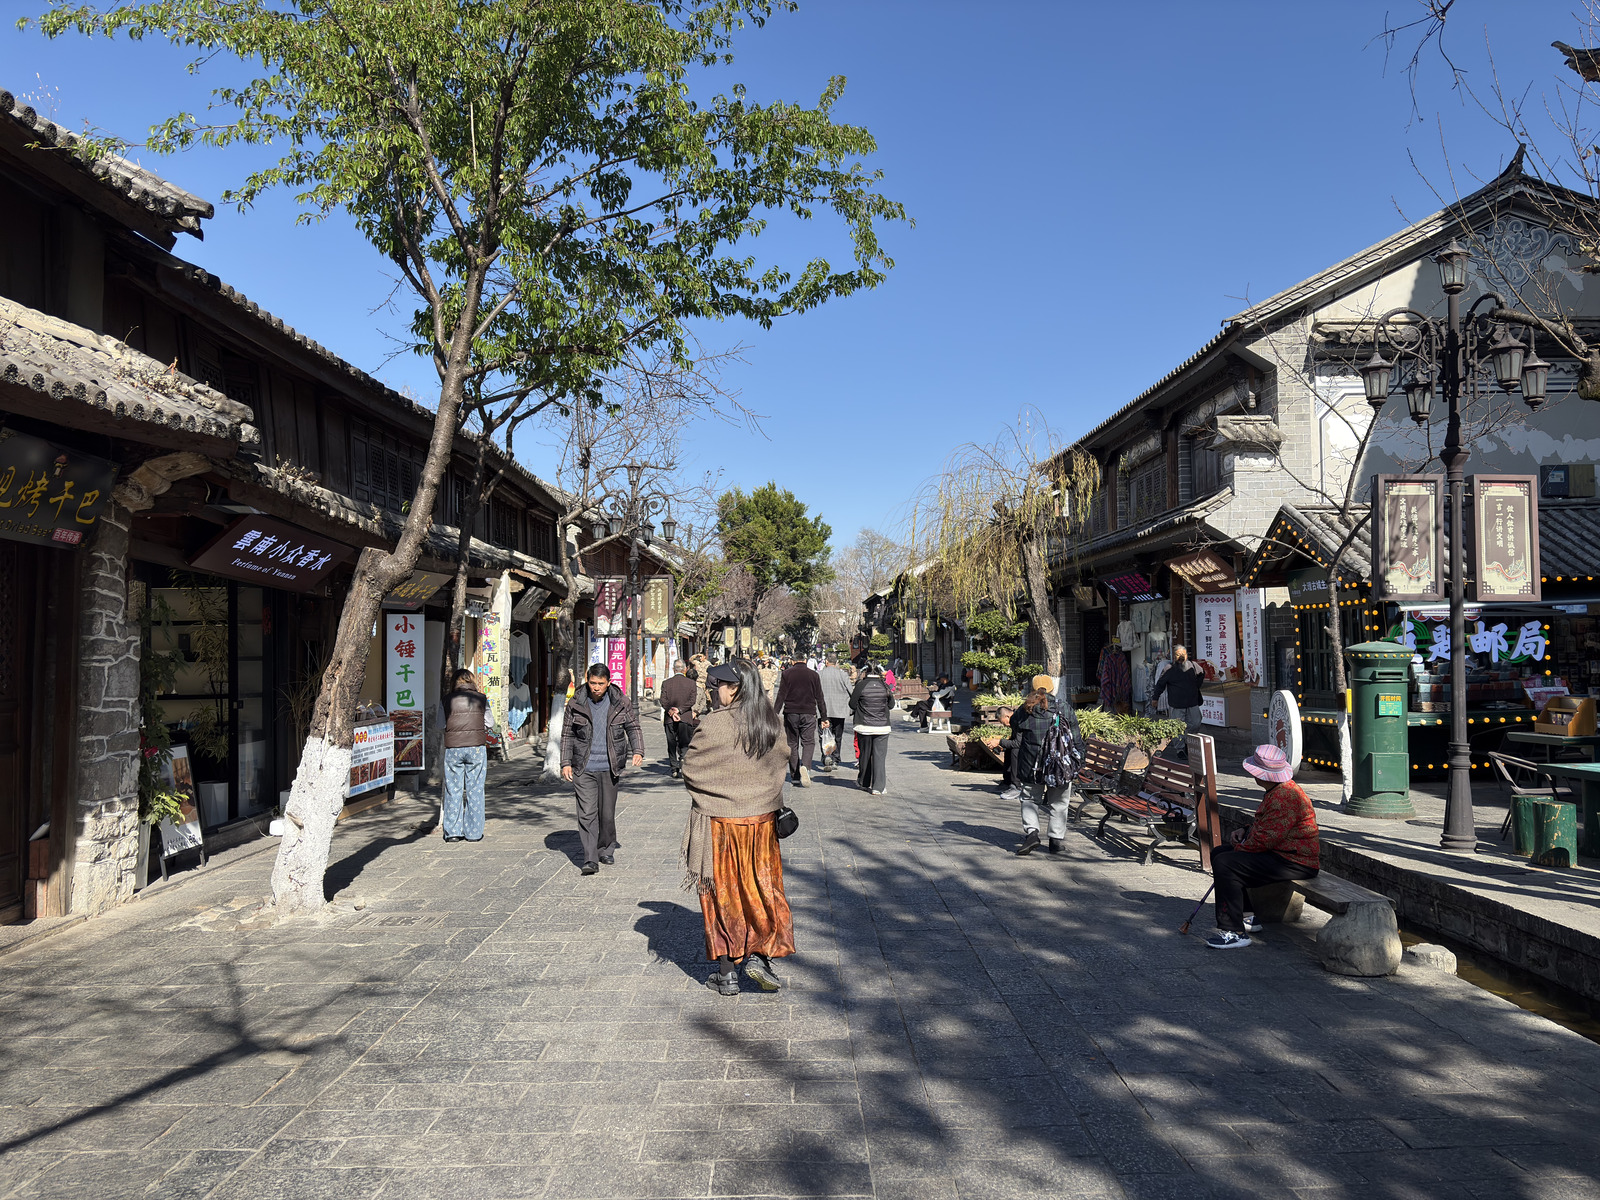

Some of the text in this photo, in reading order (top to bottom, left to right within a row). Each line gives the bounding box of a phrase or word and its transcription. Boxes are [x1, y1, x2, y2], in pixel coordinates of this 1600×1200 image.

[54, 529, 80, 542] 百年传承
[1495, 498, 1504, 548] 一言一行讲文明
[1506, 505, 1516, 557] 做人做事讲诚信
[231, 558, 262, 572] Perfume
[272, 568, 297, 581] Yunnan
[232, 530, 332, 571] 雲南小众香水
[1204, 610, 1212, 632] 纯手工
[1218, 613, 1228, 668] 买5盒 送5盒
[394, 616, 416, 707] 小锤干巴
[486, 652, 500, 687] 瓦猫
